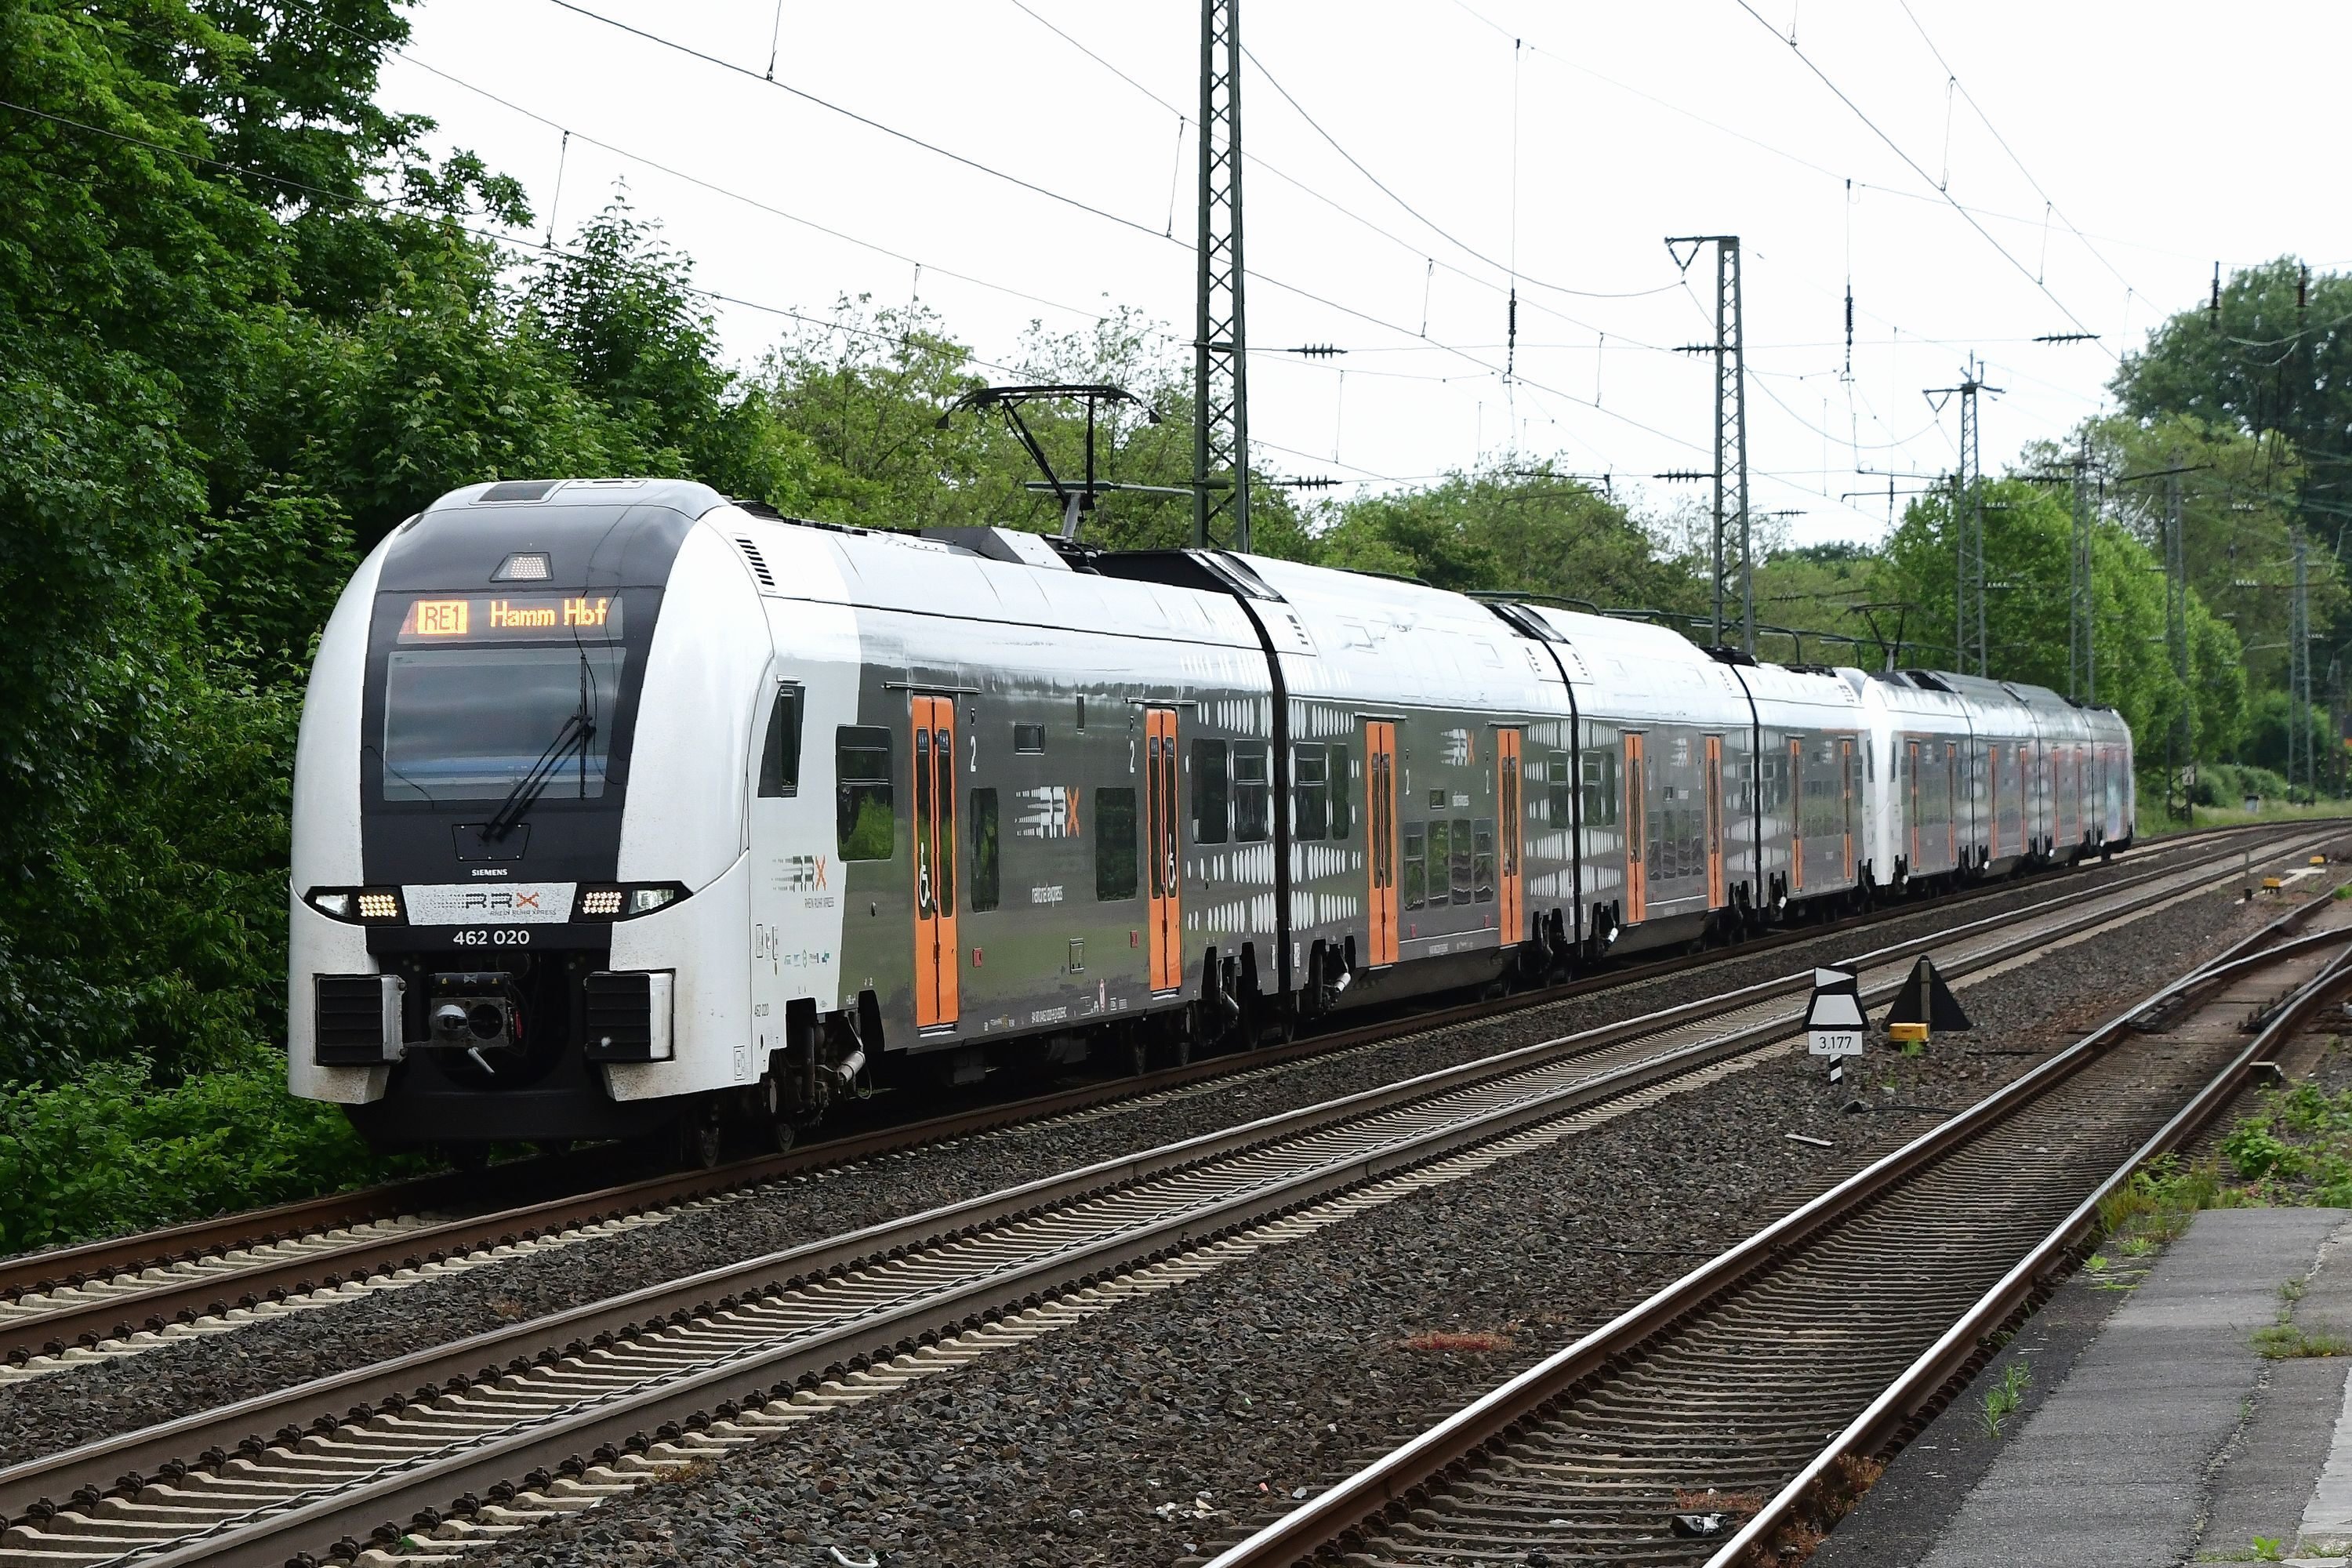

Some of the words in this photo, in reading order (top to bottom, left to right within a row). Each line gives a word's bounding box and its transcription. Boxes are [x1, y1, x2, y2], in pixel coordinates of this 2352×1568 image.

[424, 604, 459, 632] RE1
[490, 599, 555, 627] Hamm
[563, 597, 607, 626] Hbf
[971, 735, 977, 772] 2
[1129, 740, 1135, 773] 2
[452, 931, 488, 946] 462
[493, 930, 530, 945] 020
[1819, 1036, 1853, 1050] 3.177
